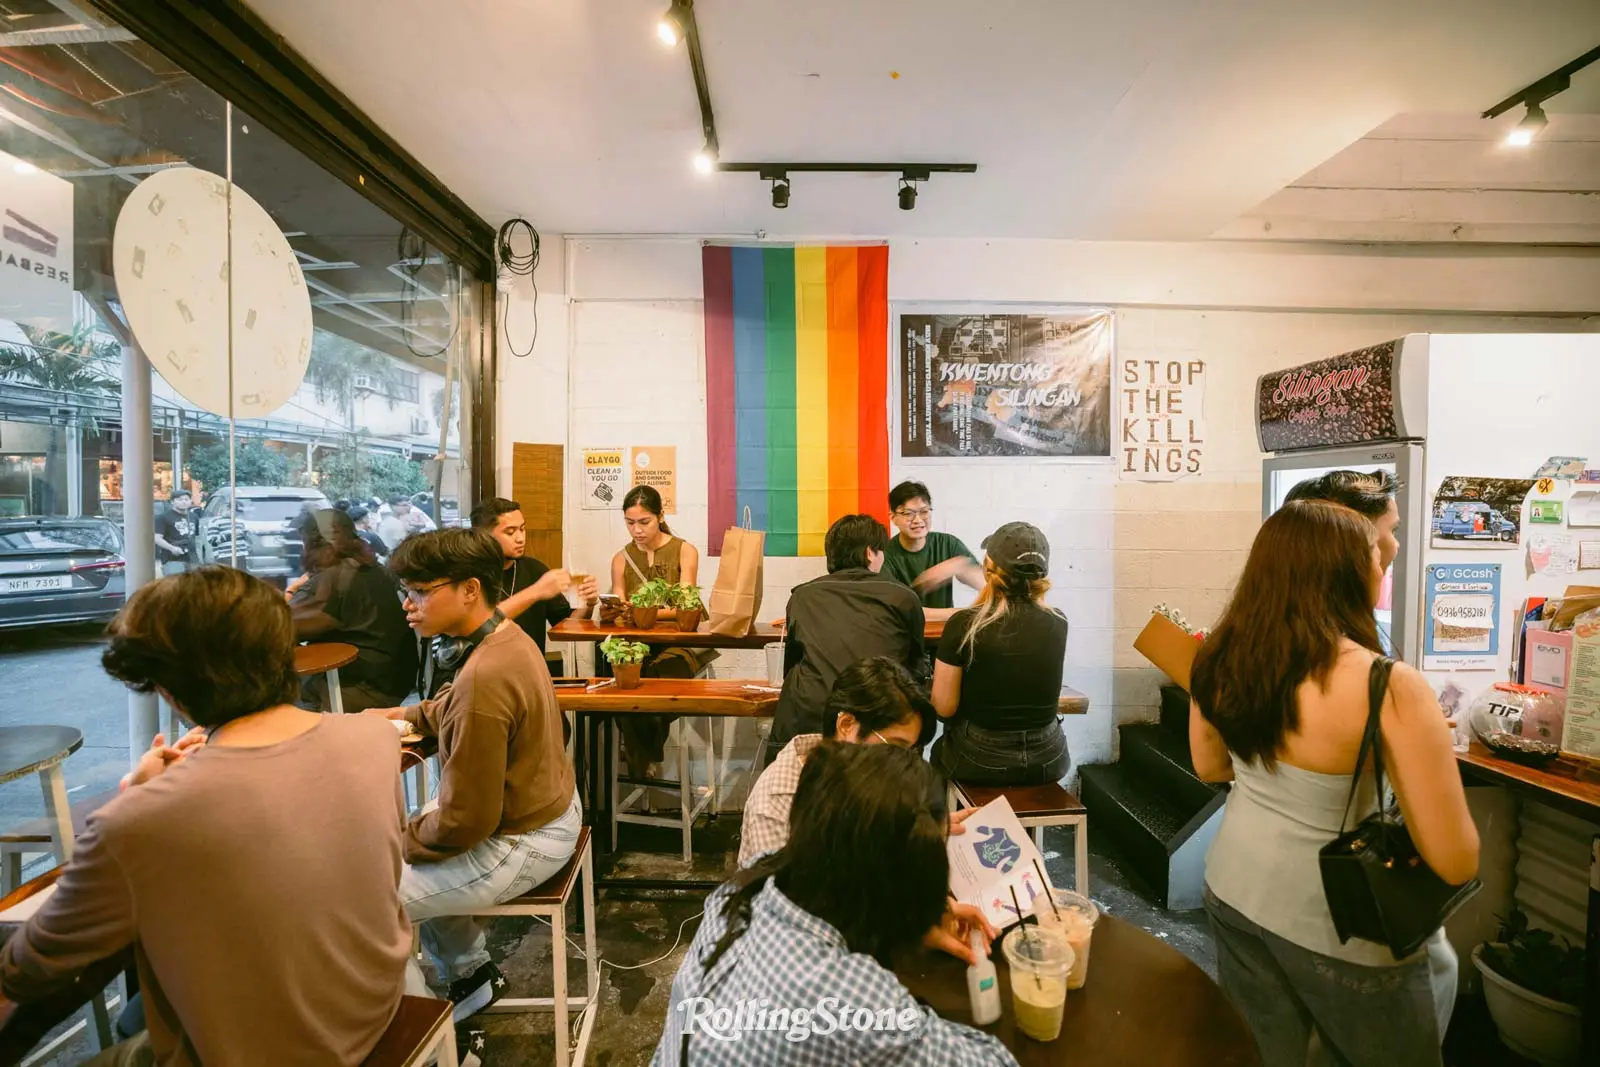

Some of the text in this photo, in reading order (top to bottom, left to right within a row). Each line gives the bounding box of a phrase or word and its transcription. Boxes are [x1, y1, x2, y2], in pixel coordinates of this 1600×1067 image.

[939, 362, 1053, 381] KWENTONG
[1124, 359, 1204, 385] STOP
[995, 382, 1082, 407] SILINGAN
[1272, 365, 1371, 405] Silingan
[1123, 389, 1182, 413] THE
[1123, 418, 1203, 443] KILL
[587, 456, 620, 464] CLAYGO
[1123, 448, 1202, 473] INGS
[9, 579, 61, 589] NFM 7391
[1453, 568, 1493, 578] GCash
[1488, 702, 1520, 717] TIP
